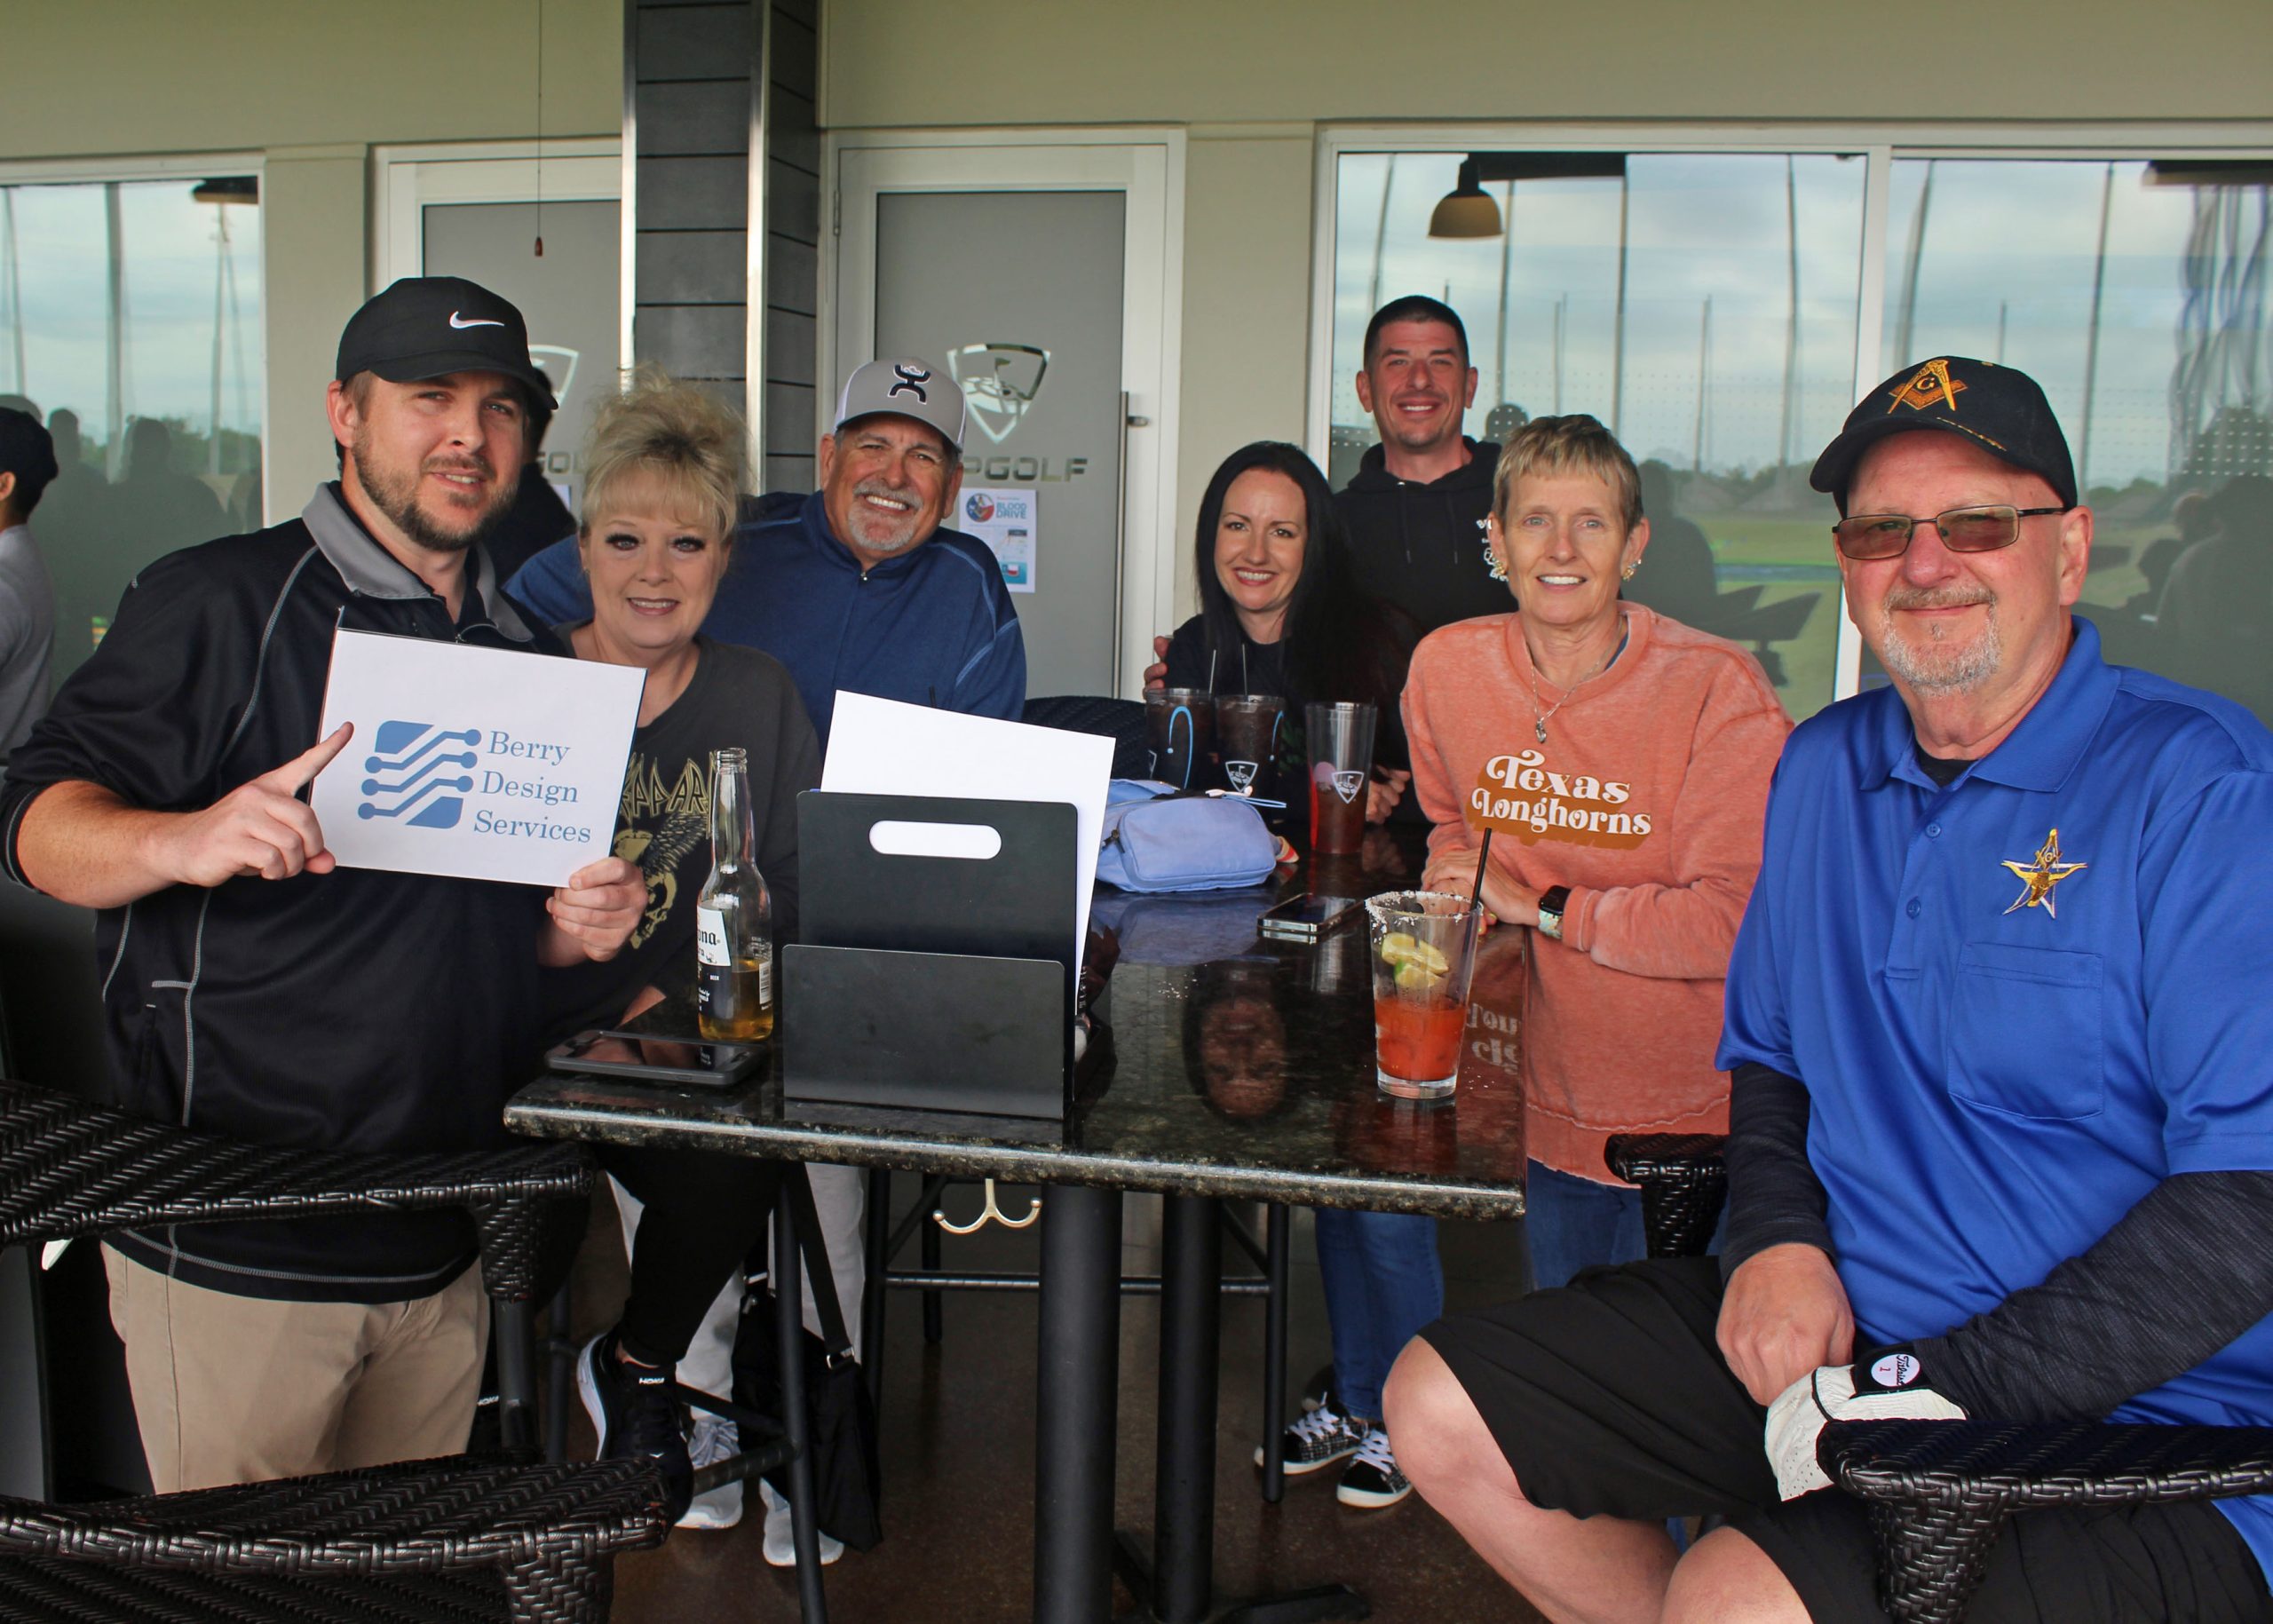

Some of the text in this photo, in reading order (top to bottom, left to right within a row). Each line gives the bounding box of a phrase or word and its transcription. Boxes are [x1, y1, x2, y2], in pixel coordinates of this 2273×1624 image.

[963, 456, 1088, 482] PGOLF
[996, 502, 1027, 511] BLOOD
[996, 509, 1027, 519] DRIVE
[487, 730, 571, 766] Berry
[479, 770, 579, 806] Design
[1485, 749, 1631, 804] Texas
[473, 809, 592, 844] Services
[1471, 787, 1652, 836] Longhorns
